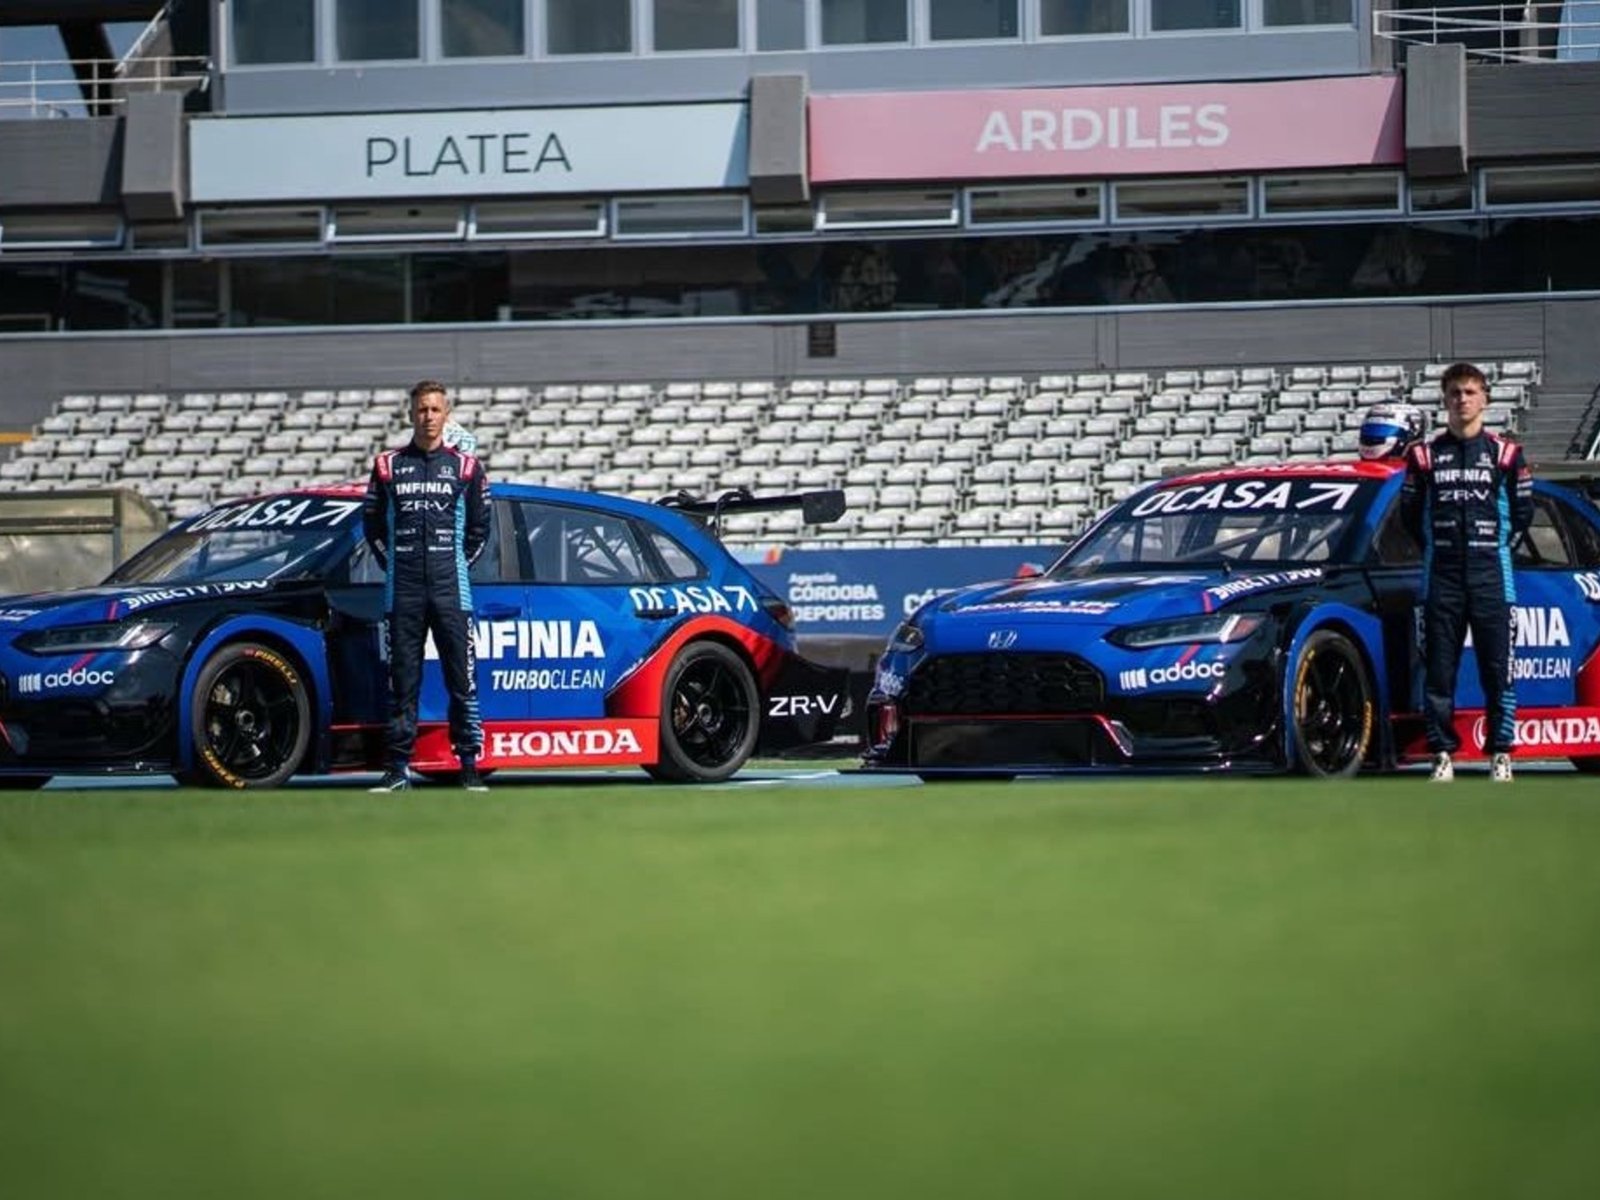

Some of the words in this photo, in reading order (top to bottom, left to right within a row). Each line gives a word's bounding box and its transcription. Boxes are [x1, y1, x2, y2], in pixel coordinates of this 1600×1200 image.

[976, 104, 1230, 152] ARDILES
[366, 132, 573, 177] PLATEA
[1434, 469, 1492, 483] INFINIA
[396, 482, 453, 495] INFINIA
[1131, 481, 1292, 517] OCASA
[186, 499, 312, 532] OCASA
[401, 500, 448, 511] ZR-V
[790, 604, 885, 622] DEPORTES
[472, 620, 606, 659] NFINIA
[44, 667, 114, 688] addoc
[491, 669, 606, 691] TURBOCLEAN
[1149, 660, 1225, 684] addoc
[769, 693, 838, 716] ZR-V
[492, 728, 642, 757] HONDA
